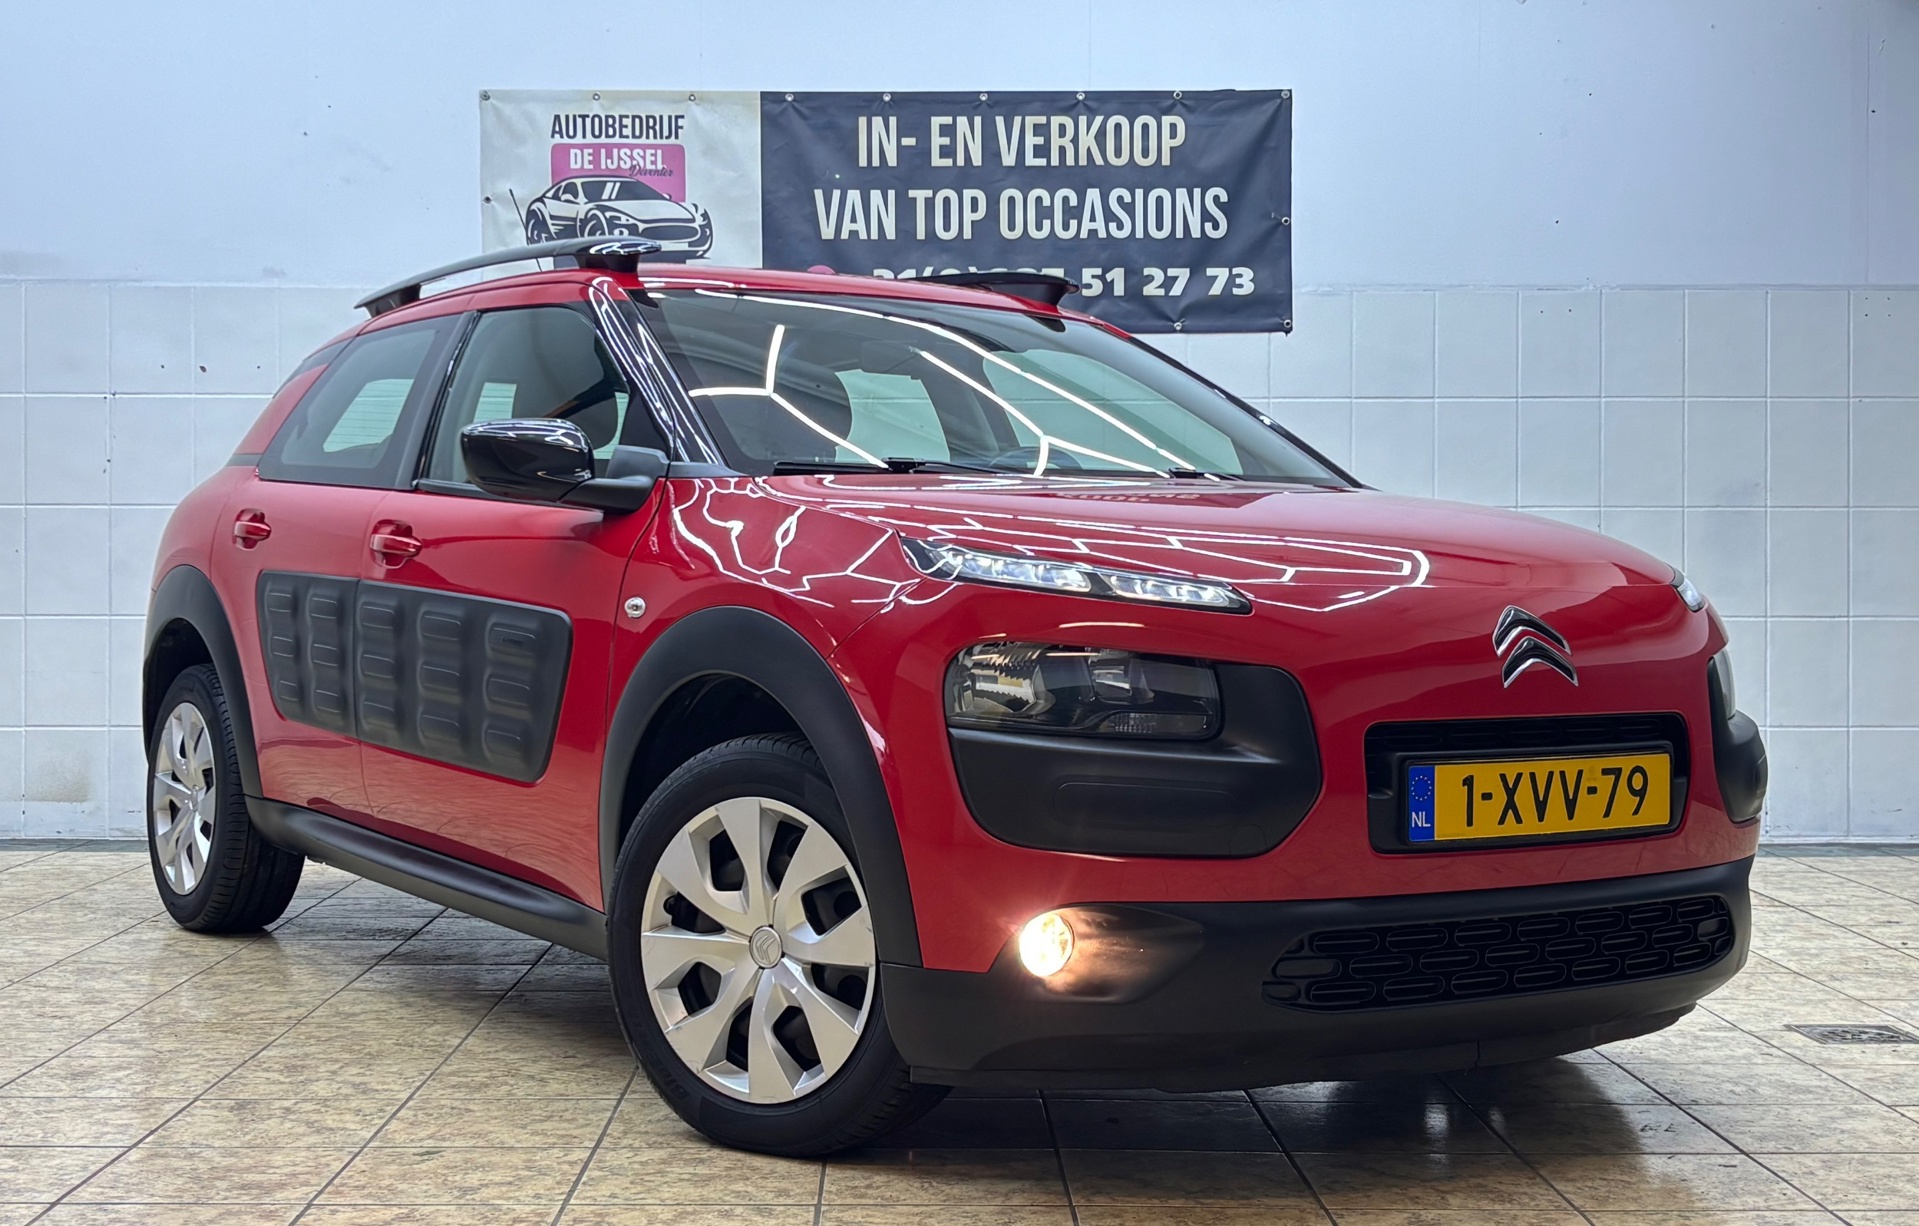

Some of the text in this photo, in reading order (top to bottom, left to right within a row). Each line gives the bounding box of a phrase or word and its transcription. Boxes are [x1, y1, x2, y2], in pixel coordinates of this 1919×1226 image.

[550, 114, 685, 140] AUTOBEDRIJF
[857, 114, 1186, 168] IN- EN VERKOOP
[569, 148, 666, 170] DE IJSSEL
[813, 186, 1229, 241] VAN TOP OCCASIONS
[1081, 267, 1126, 297] 51
[1142, 267, 1191, 297] 27
[1206, 266, 1256, 297] 73
[1462, 764, 1649, 828] 1-XVV-79
[1411, 811, 1431, 828] NL
